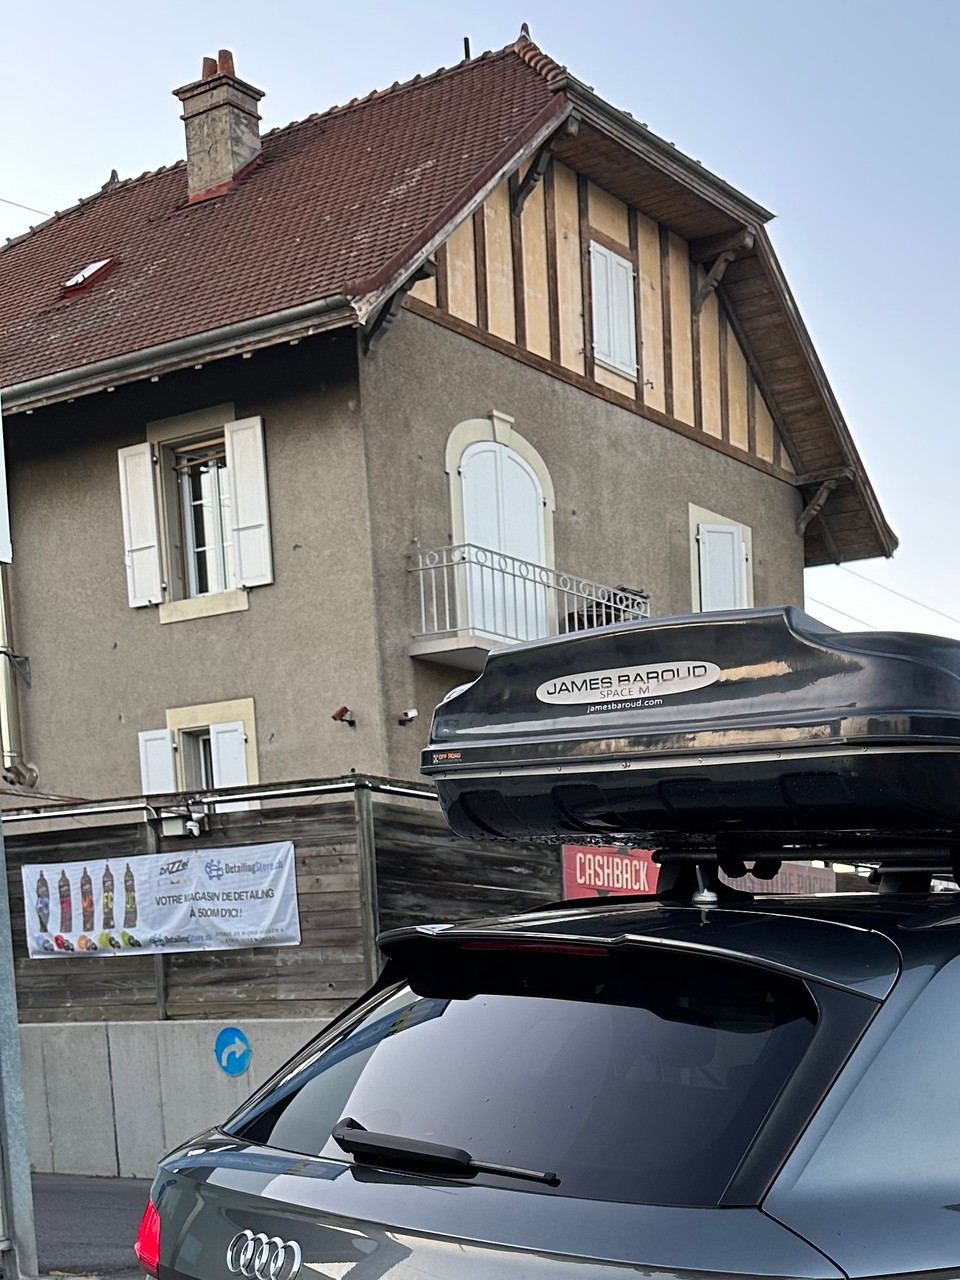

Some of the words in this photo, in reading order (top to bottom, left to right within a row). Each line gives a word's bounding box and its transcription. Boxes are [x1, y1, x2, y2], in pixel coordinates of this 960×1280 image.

[547, 676, 613, 695] JAMES
[617, 664, 708, 688] BAROUD
[599, 687, 634, 699] SPACE
[639, 685, 650, 695] M
[587, 698, 663, 713] jamesbaroud.com
[576, 852, 649, 891] CASHBACK
[155, 894, 183, 906] VOTRE
[184, 891, 221, 903] MAGASIN
[222, 892, 233, 902] DE
